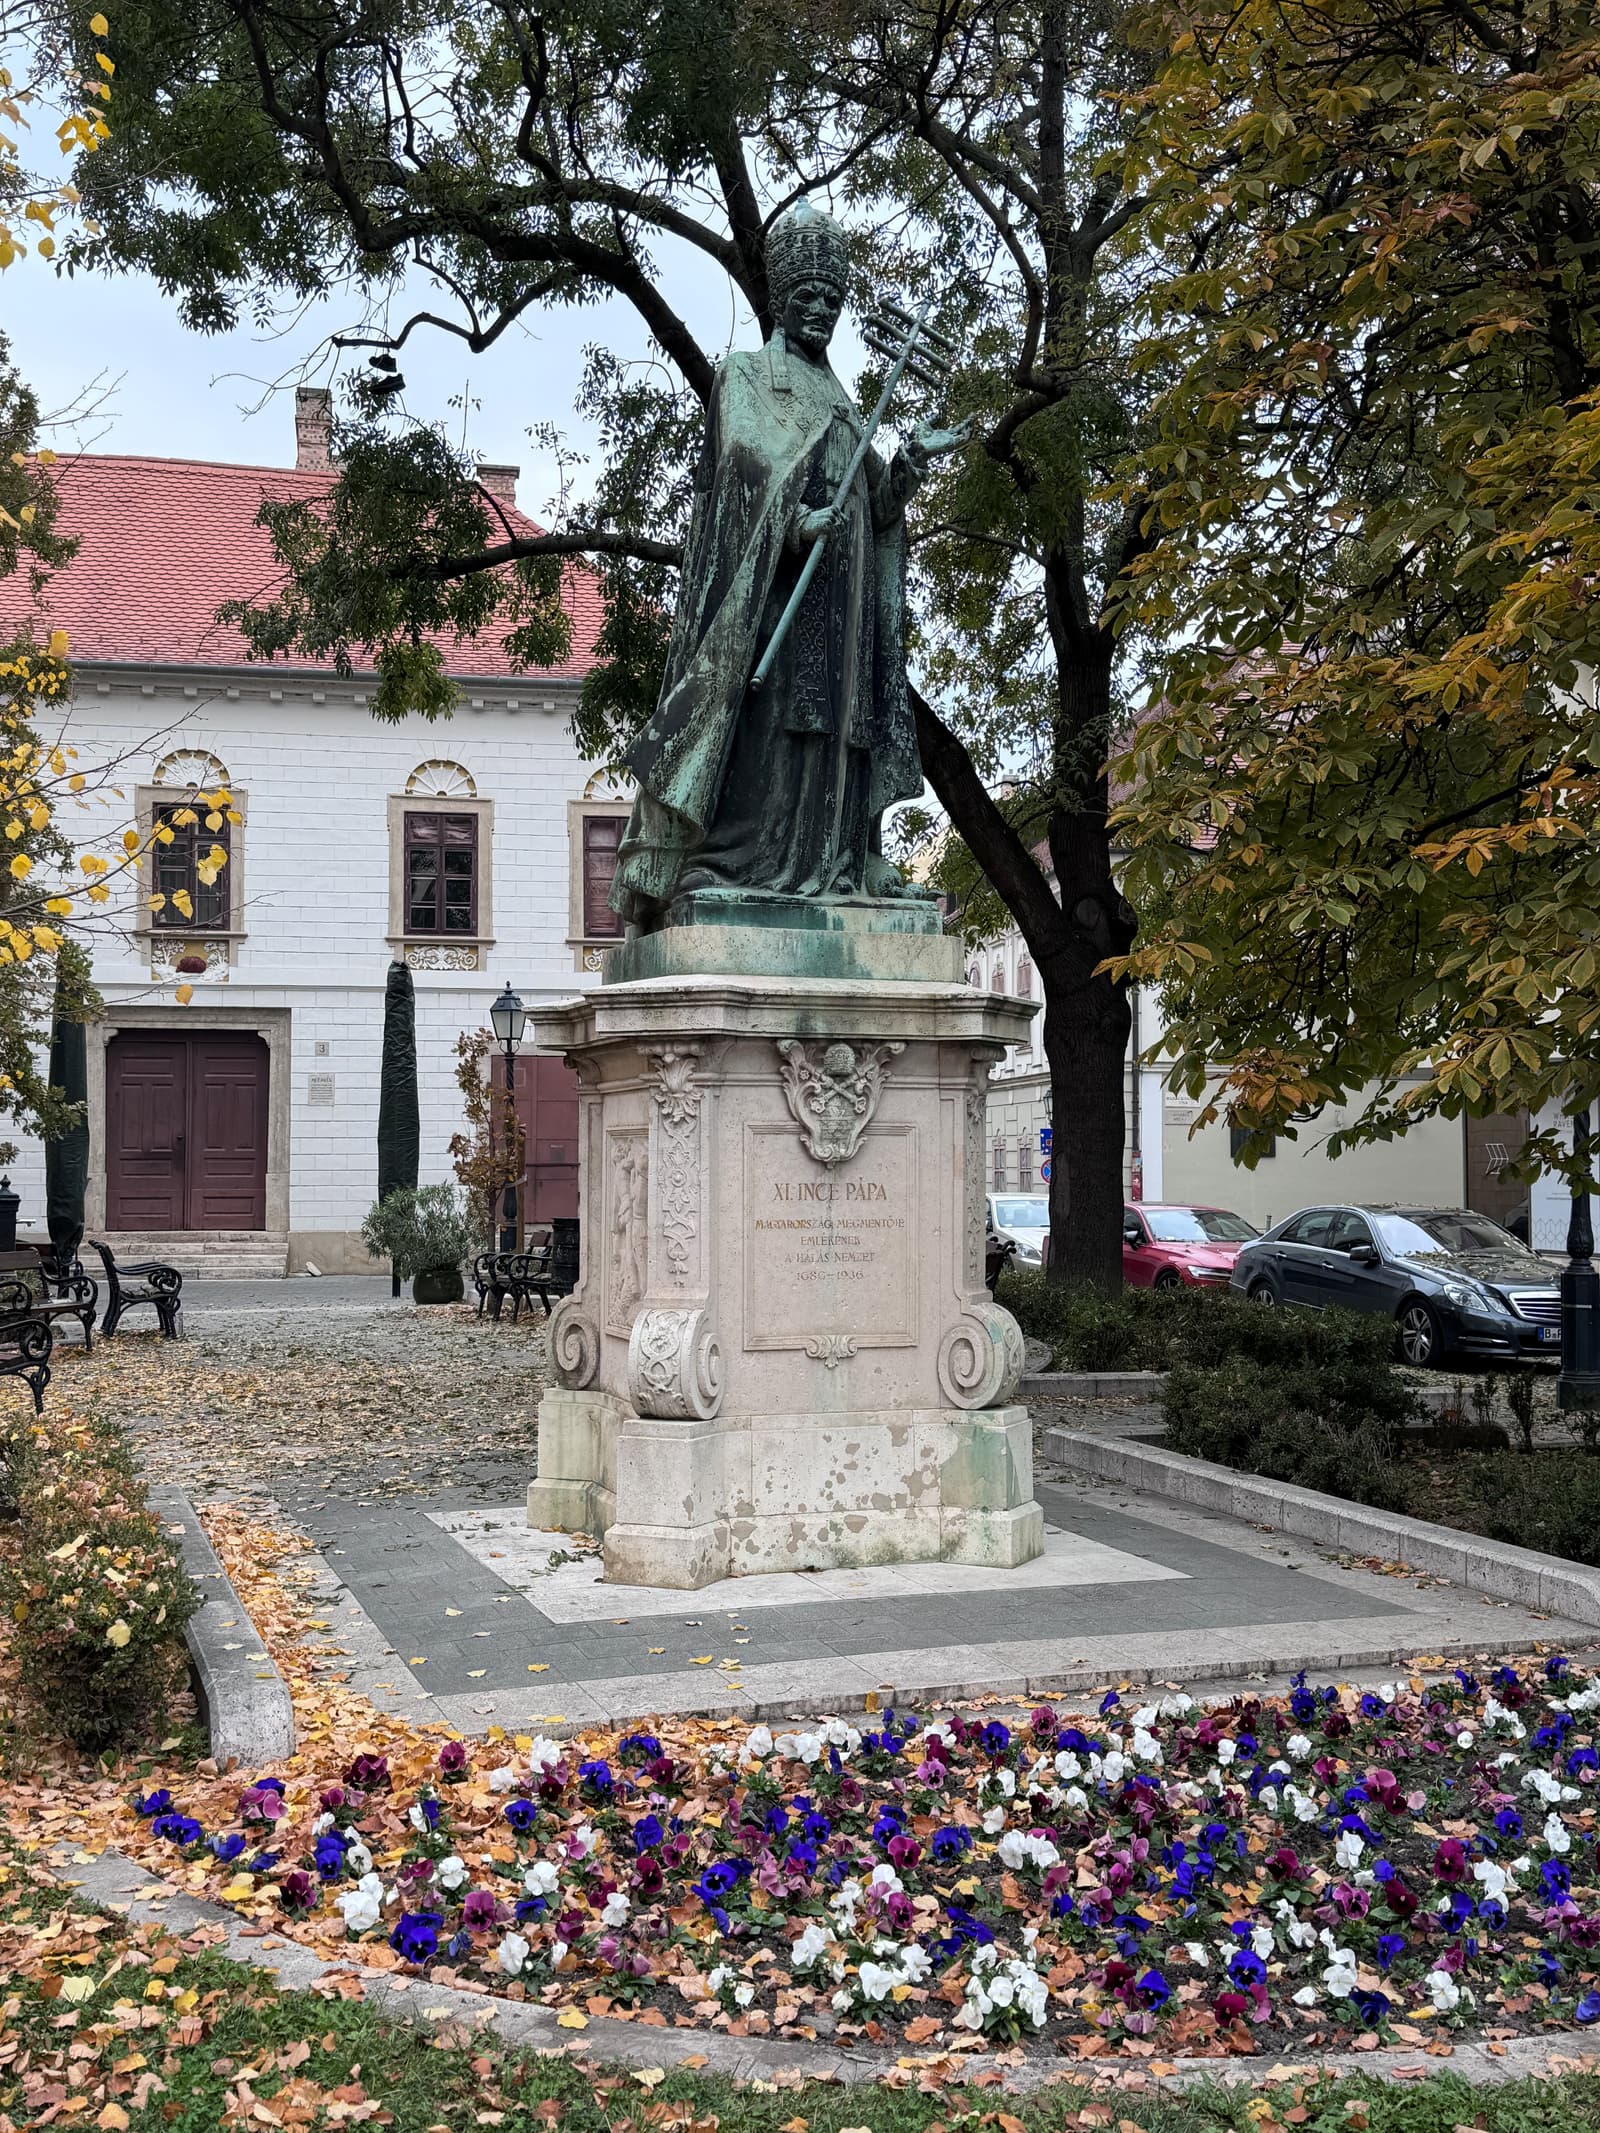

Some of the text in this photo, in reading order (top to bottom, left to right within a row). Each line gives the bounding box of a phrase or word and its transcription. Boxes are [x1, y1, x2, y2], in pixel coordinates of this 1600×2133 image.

[319, 1044, 326, 1053] 3
[773, 1177, 888, 1201] XI. INCE PÁPA
[755, 1216, 833, 1230] MAGYARORSZÁG
[801, 1232, 861, 1246] EMLÉKÉNEK
[784, 1250, 875, 1263] A HÁLÁS NEMZET
